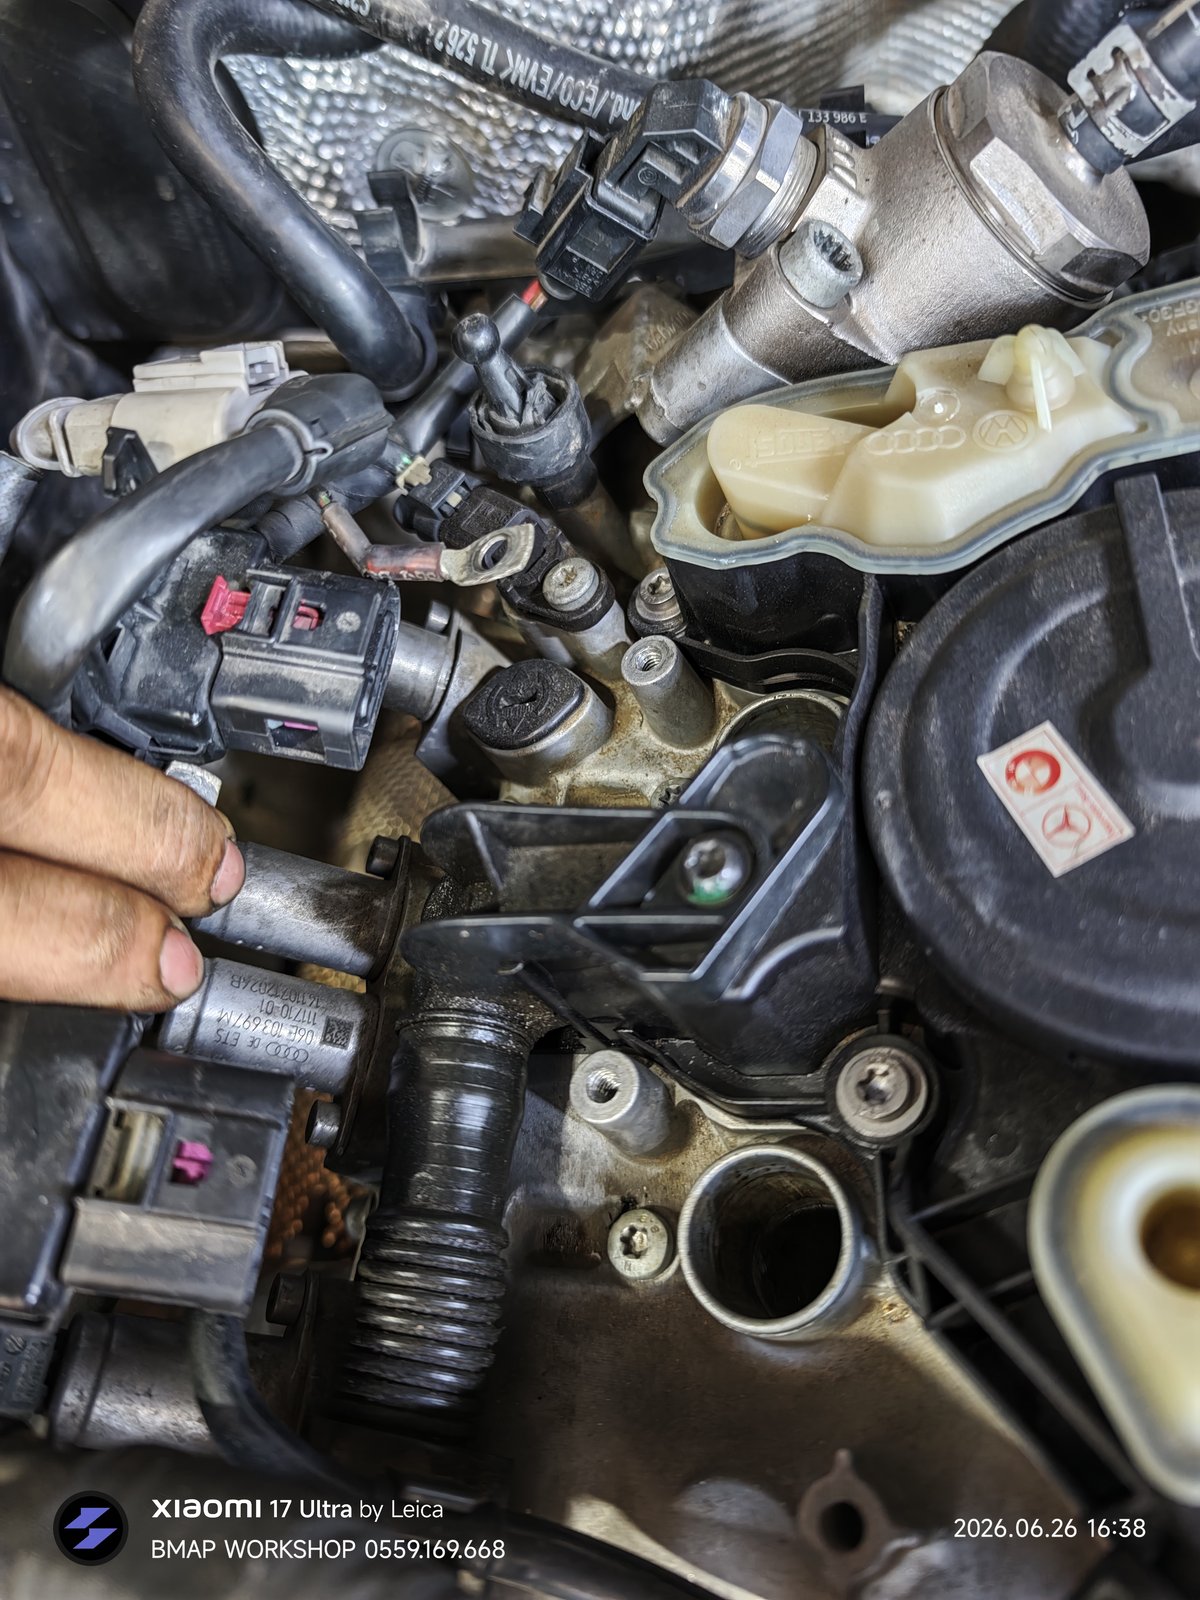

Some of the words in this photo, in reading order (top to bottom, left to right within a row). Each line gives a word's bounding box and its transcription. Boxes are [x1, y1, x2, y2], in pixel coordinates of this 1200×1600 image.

[480, 37, 499, 76] TL
[807, 110, 830, 123] 133
[833, 111, 856, 124] 986
[214, 1028, 242, 1047] ETS
[288, 1025, 315, 1046] 06E
